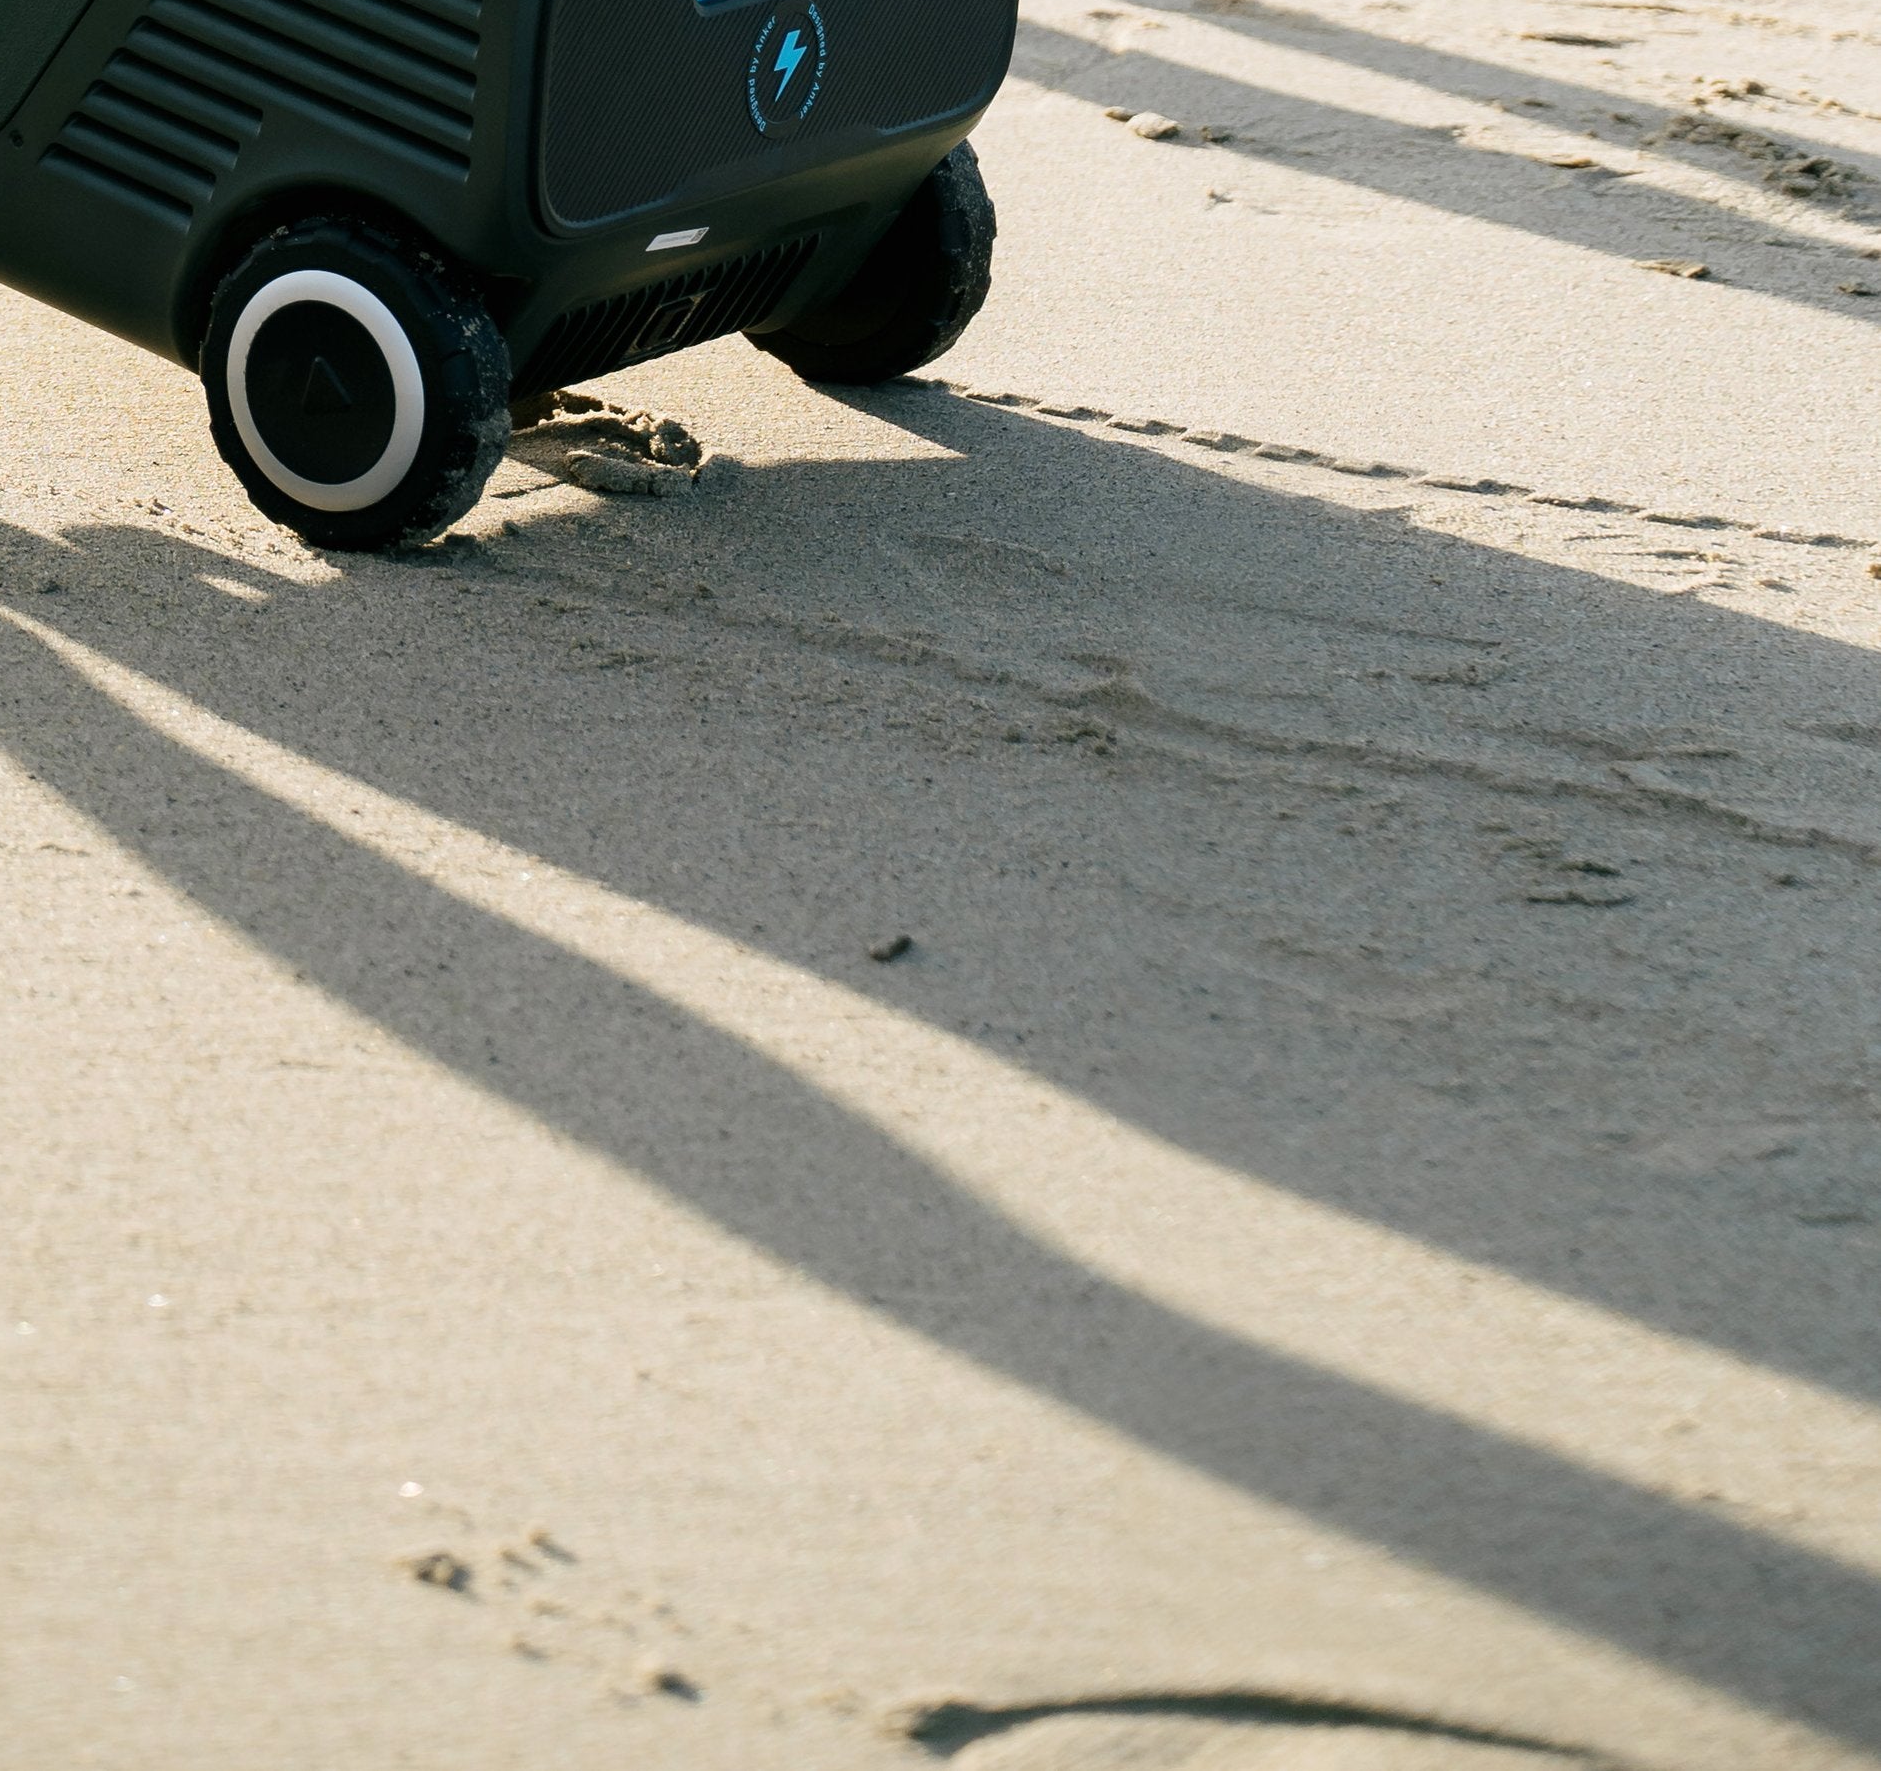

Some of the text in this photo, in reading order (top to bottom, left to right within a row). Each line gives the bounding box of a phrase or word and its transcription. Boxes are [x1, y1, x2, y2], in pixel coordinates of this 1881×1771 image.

[748, 15, 776, 132] Designed by Anker
[800, 3, 826, 119] Designed by Anker
